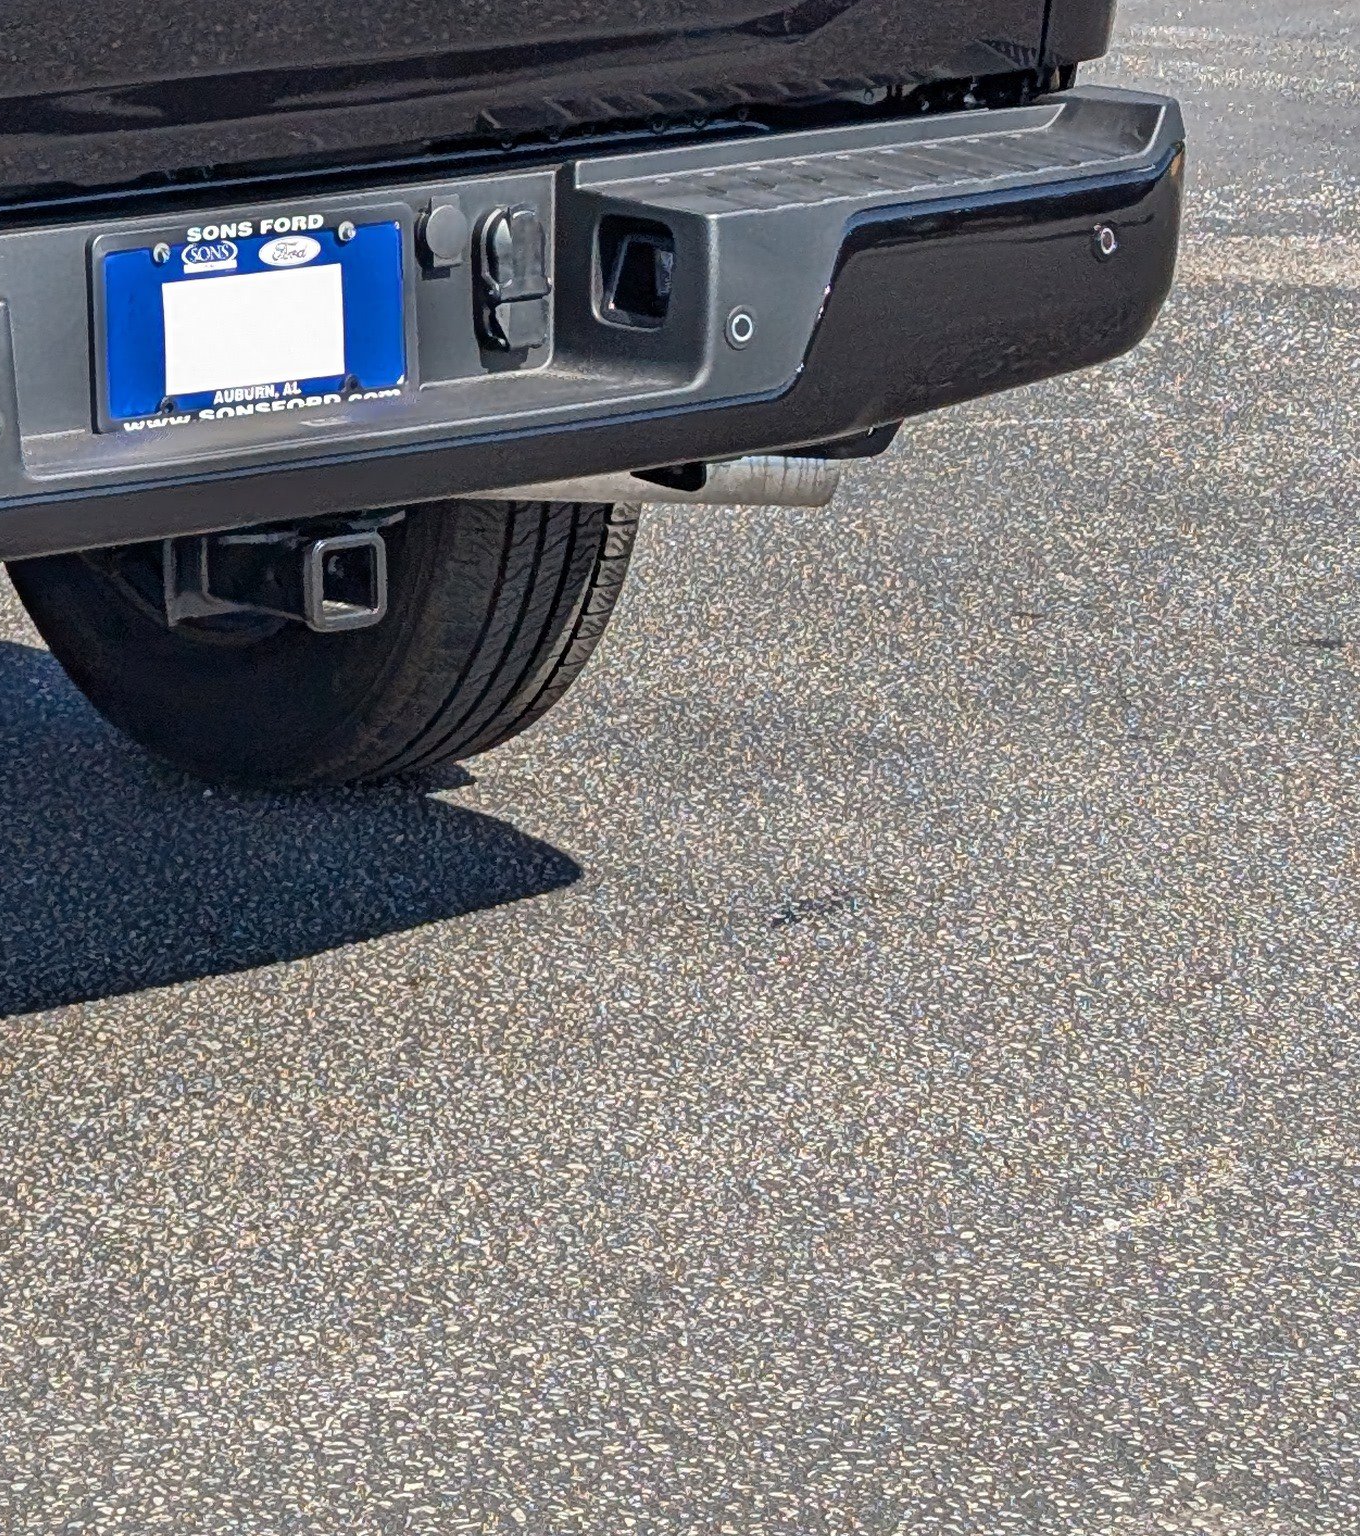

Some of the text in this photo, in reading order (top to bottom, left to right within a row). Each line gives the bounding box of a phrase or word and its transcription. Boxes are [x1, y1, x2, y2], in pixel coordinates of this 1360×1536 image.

[186, 213, 325, 243] SONS FORD
[190, 243, 230, 263] SONS
[212, 380, 303, 406] AUBURN, AL
[123, 388, 402, 432] wwwSONSFORDcom
